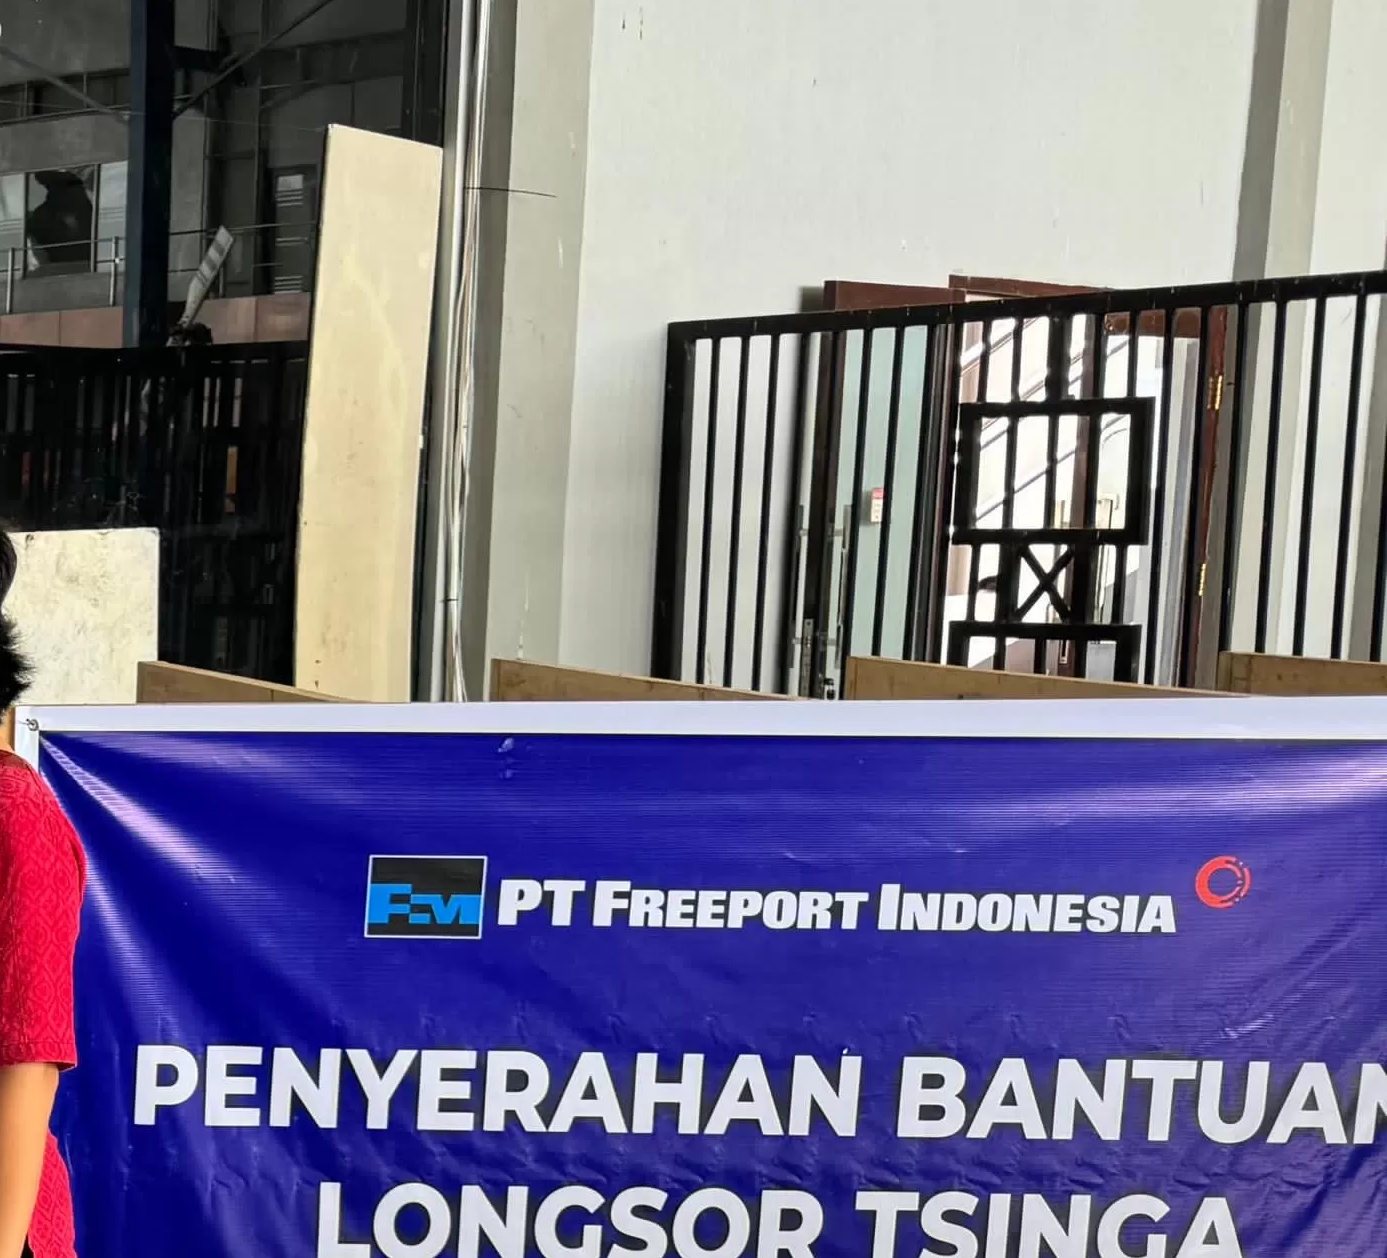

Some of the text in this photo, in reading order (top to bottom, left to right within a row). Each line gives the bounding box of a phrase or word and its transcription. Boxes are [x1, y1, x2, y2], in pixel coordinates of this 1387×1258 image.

[498, 880, 585, 926] PT
[594, 881, 868, 929] FREEPORT
[879, 884, 1175, 933] INDONESIA
[135, 1046, 861, 1136] PENYERAHAN
